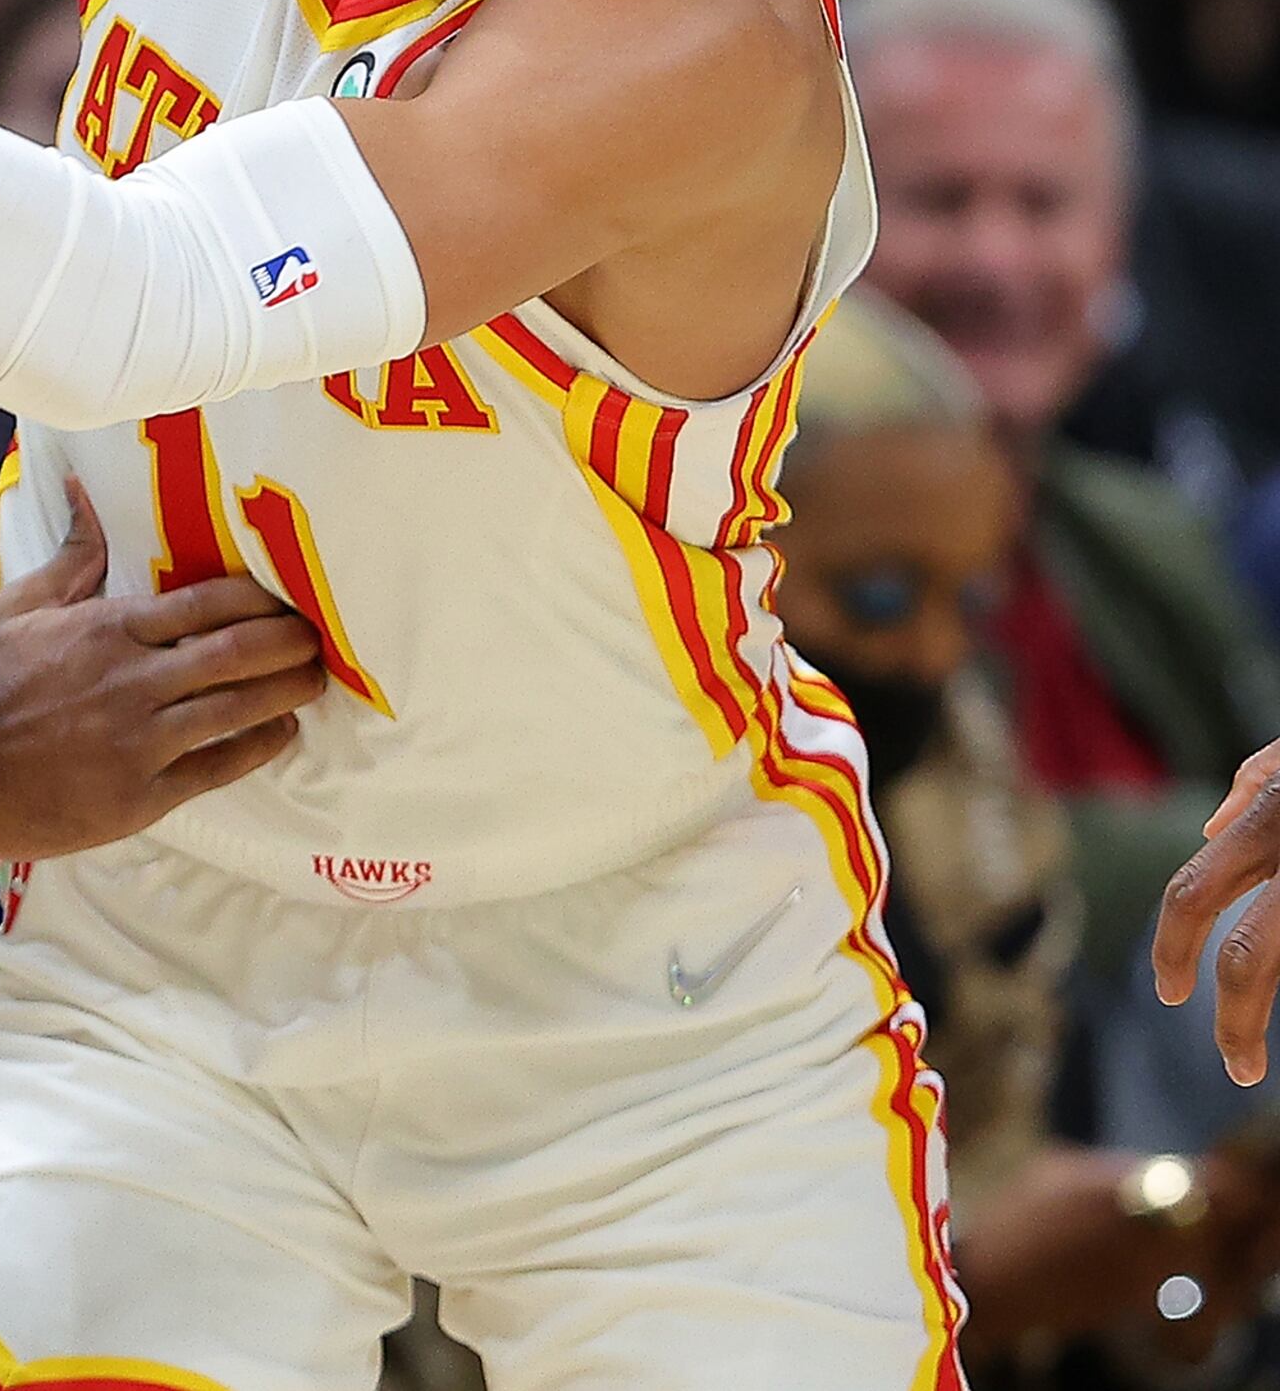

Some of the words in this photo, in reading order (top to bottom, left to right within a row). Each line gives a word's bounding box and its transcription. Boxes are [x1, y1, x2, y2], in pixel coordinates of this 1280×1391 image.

[251, 265, 275, 298] NBA
[138, 406, 397, 721] 11
[310, 853, 432, 886] HAWKS
